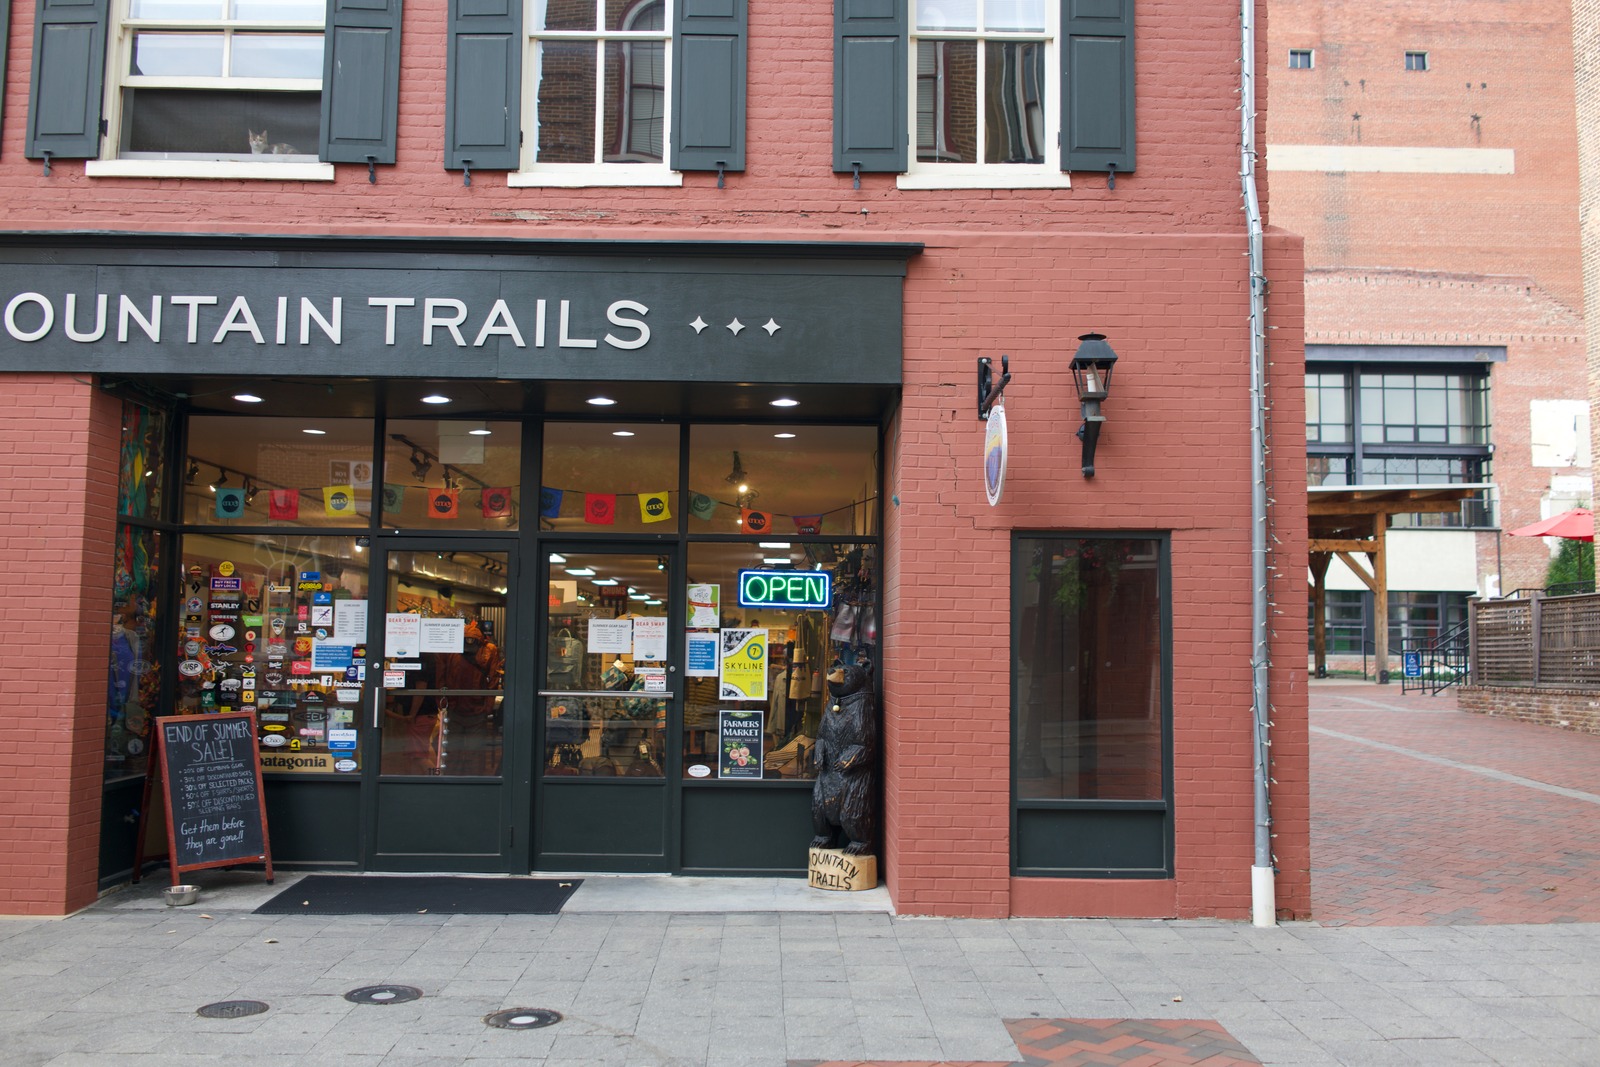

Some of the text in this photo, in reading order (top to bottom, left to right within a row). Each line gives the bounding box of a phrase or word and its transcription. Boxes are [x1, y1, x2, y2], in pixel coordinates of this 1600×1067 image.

[3, 291, 652, 351] OUNTAIN TRAILS
[602, 586, 626, 596] CHUMS
[744, 575, 824, 602] OPEN
[166, 721, 252, 742] END OF SUMMER
[723, 720, 759, 728] FARMERS
[723, 728, 759, 736] MARKET
[192, 740, 234, 763] SALE!
[209, 779, 237, 789] SELECTED
[201, 799, 212, 808] OFF
[213, 794, 255, 806] DISCONTINUED
[181, 816, 246, 835] Get them before
[185, 836, 203, 856] they
[811, 852, 860, 878] OUNTAIN
[810, 870, 852, 890] TRAILS
